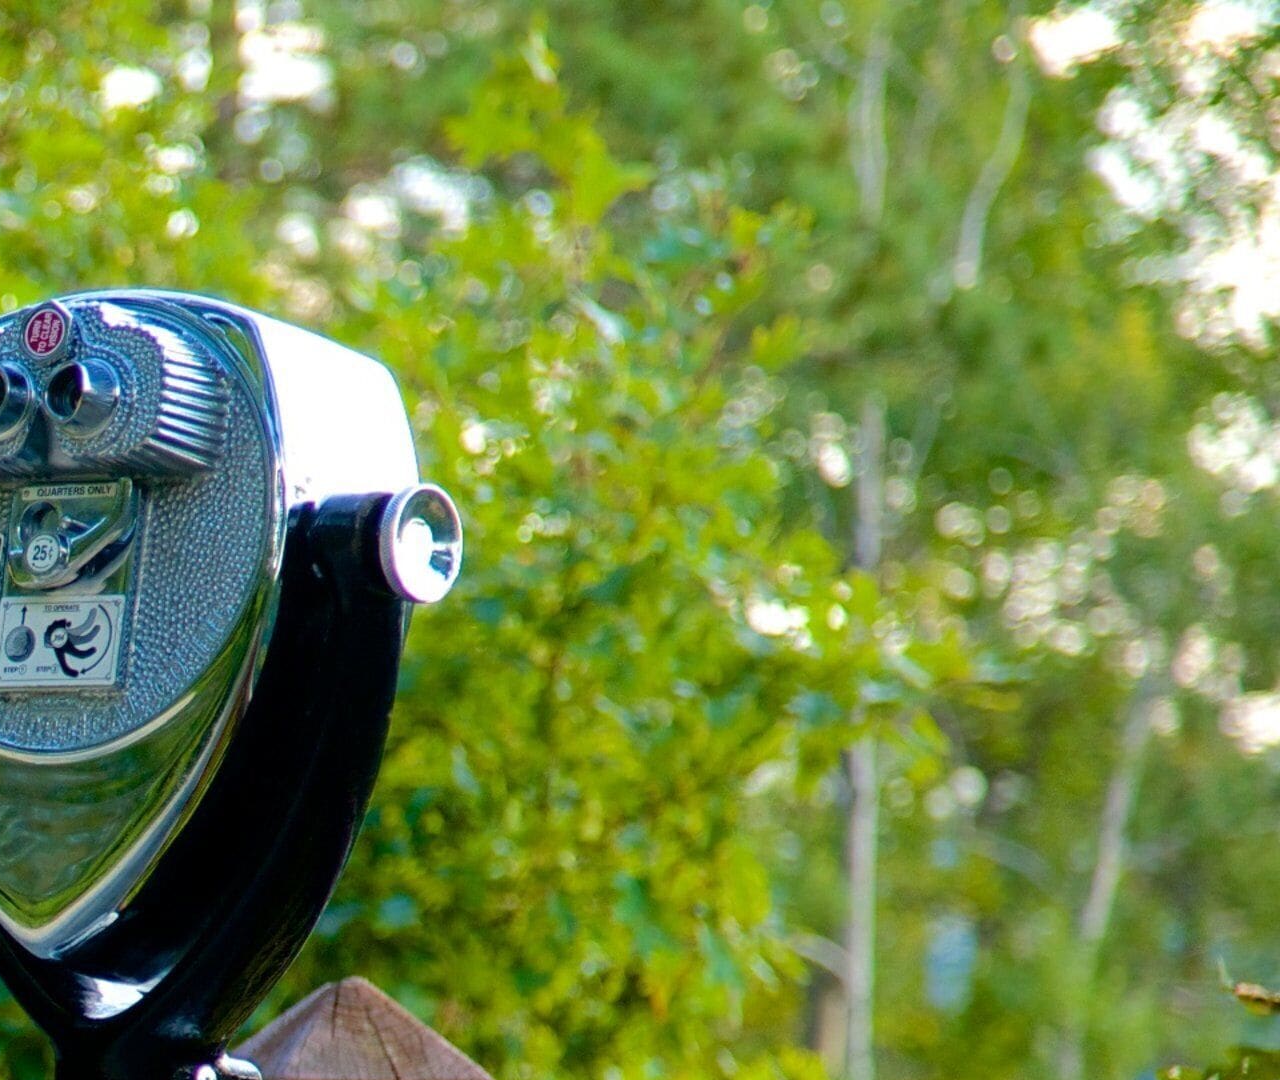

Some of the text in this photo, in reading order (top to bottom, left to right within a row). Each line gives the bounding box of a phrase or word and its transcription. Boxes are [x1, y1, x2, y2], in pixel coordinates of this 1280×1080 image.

[30, 320, 41, 343] TURN
[37, 312, 53, 352] TO CLEAR
[48, 320, 61, 347] VISION
[37, 486, 112, 497] QUARTERS ONLY
